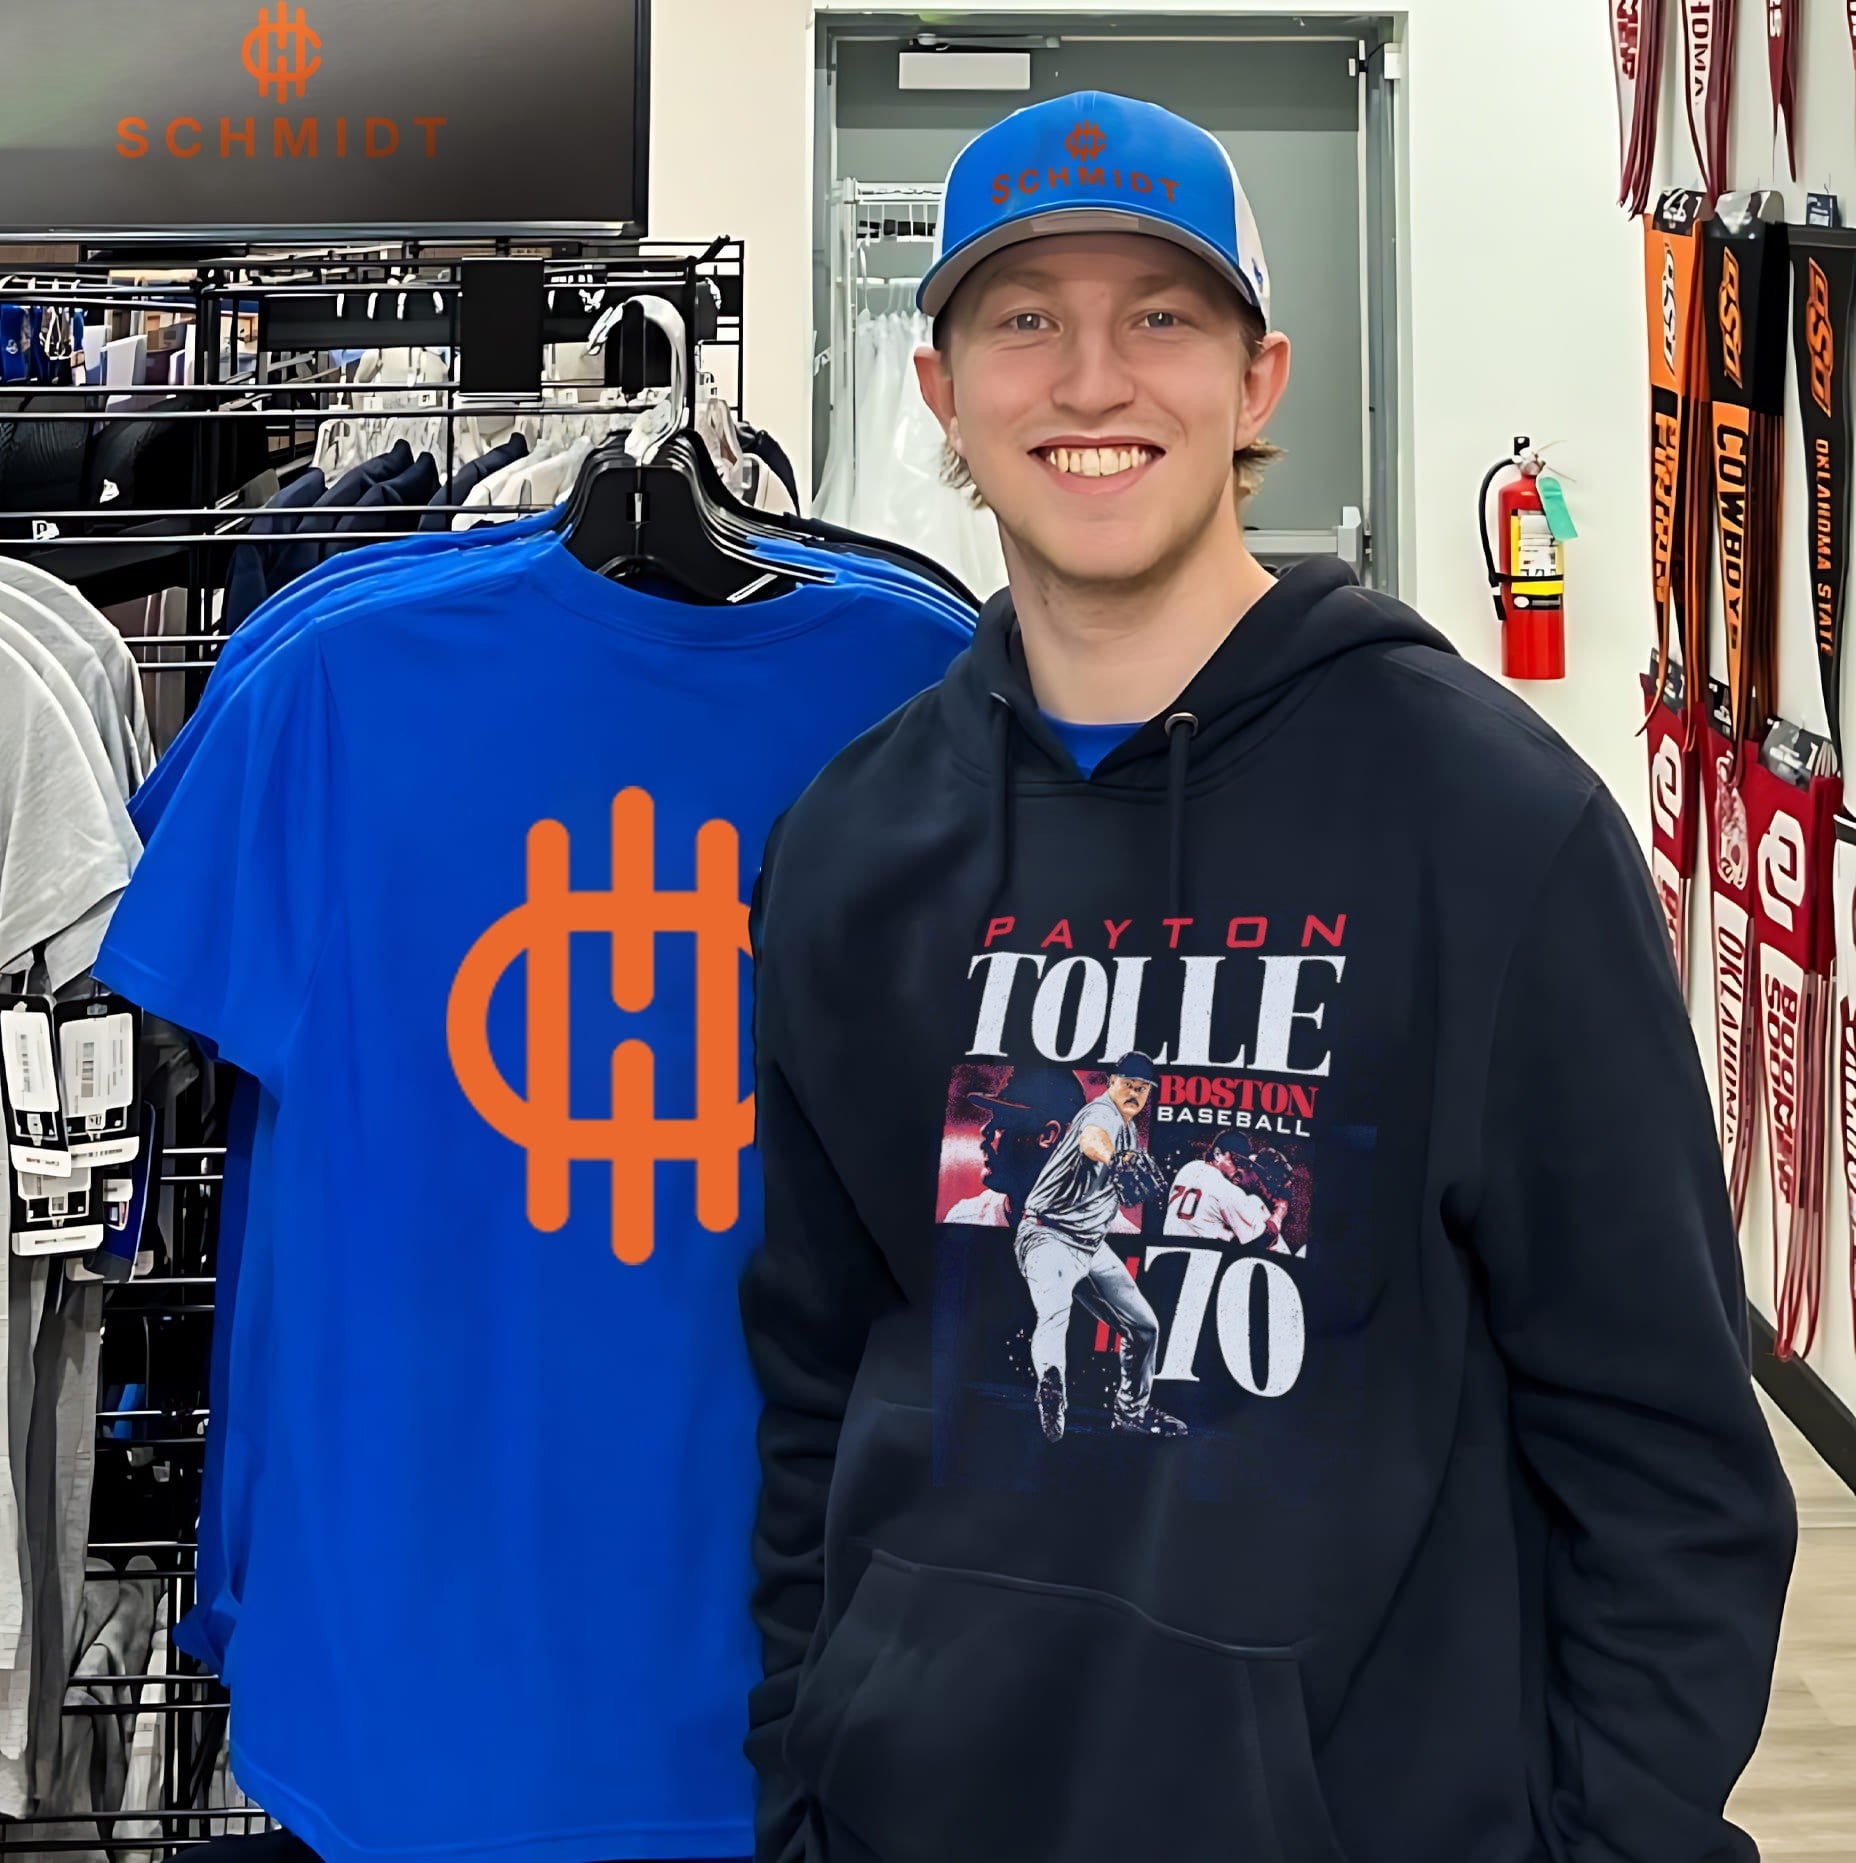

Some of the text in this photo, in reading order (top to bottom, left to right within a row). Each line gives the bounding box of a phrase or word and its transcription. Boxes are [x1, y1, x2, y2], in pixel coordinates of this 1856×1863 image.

[116, 116, 448, 159] SCHMIDT
[992, 167, 1179, 204] SCHMIDT
[1815, 438, 1832, 570] OKLAHOMA
[984, 913, 1347, 949] PAYTON
[965, 952, 1346, 1077] TOLLE
[1158, 1074, 1320, 1119] BOSTON
[1157, 1106, 1310, 1138] BASEBALL
[1168, 1185, 1203, 1220] 70
[1144, 1246, 1305, 1398] 70
